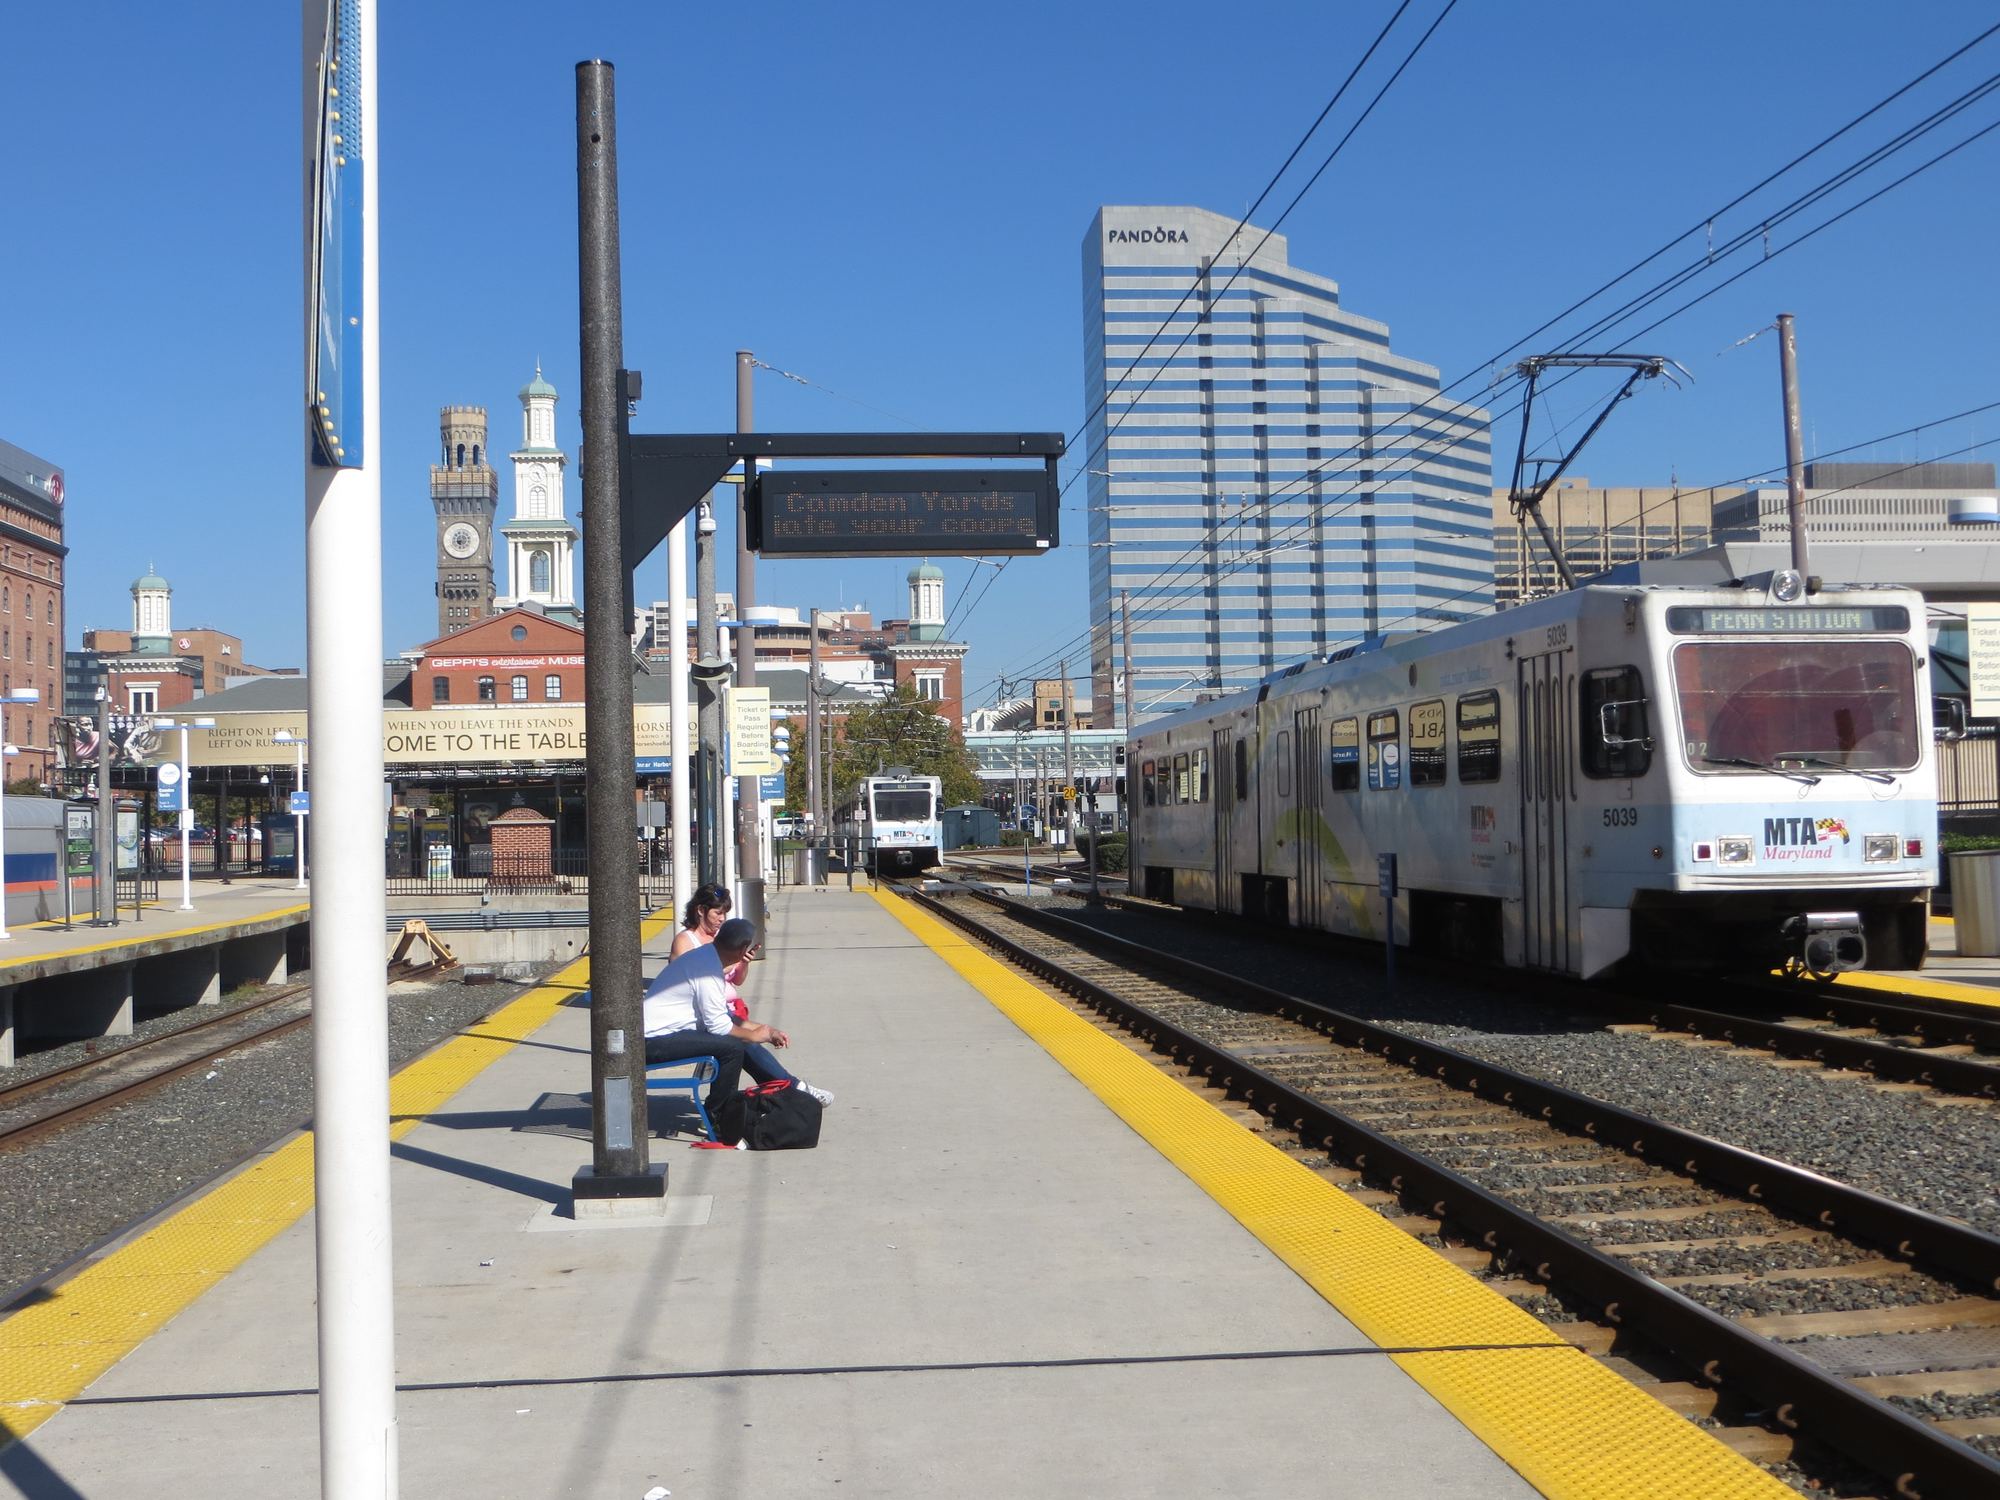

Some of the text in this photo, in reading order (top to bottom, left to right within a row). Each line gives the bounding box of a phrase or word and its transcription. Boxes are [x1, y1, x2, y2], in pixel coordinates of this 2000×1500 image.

[1108, 226, 1189, 243] PANDORA
[787, 491, 1015, 512] Camden Yards
[1711, 612, 1864, 629] PENN STATION
[1546, 623, 1568, 647] 5039
[1972, 628, 1998, 636] Ticket
[431, 658, 489, 667] GEPPI'S
[548, 656, 585, 665] MUSE
[208, 727, 244, 737] RIGHT
[246, 727, 263, 736] ON
[388, 718, 574, 731] WHEN YOU LEAVE THE STANDS
[208, 739, 233, 748] LEFT
[235, 738, 252, 748] ON
[384, 732, 586, 752] OME TO THE TABLE
[737, 741, 769, 749] Boarding
[1064, 788, 1076, 799] 20
[1603, 807, 1638, 827] 5039
[1764, 817, 1818, 846] MTA
[1762, 846, 1833, 862] Maryland
